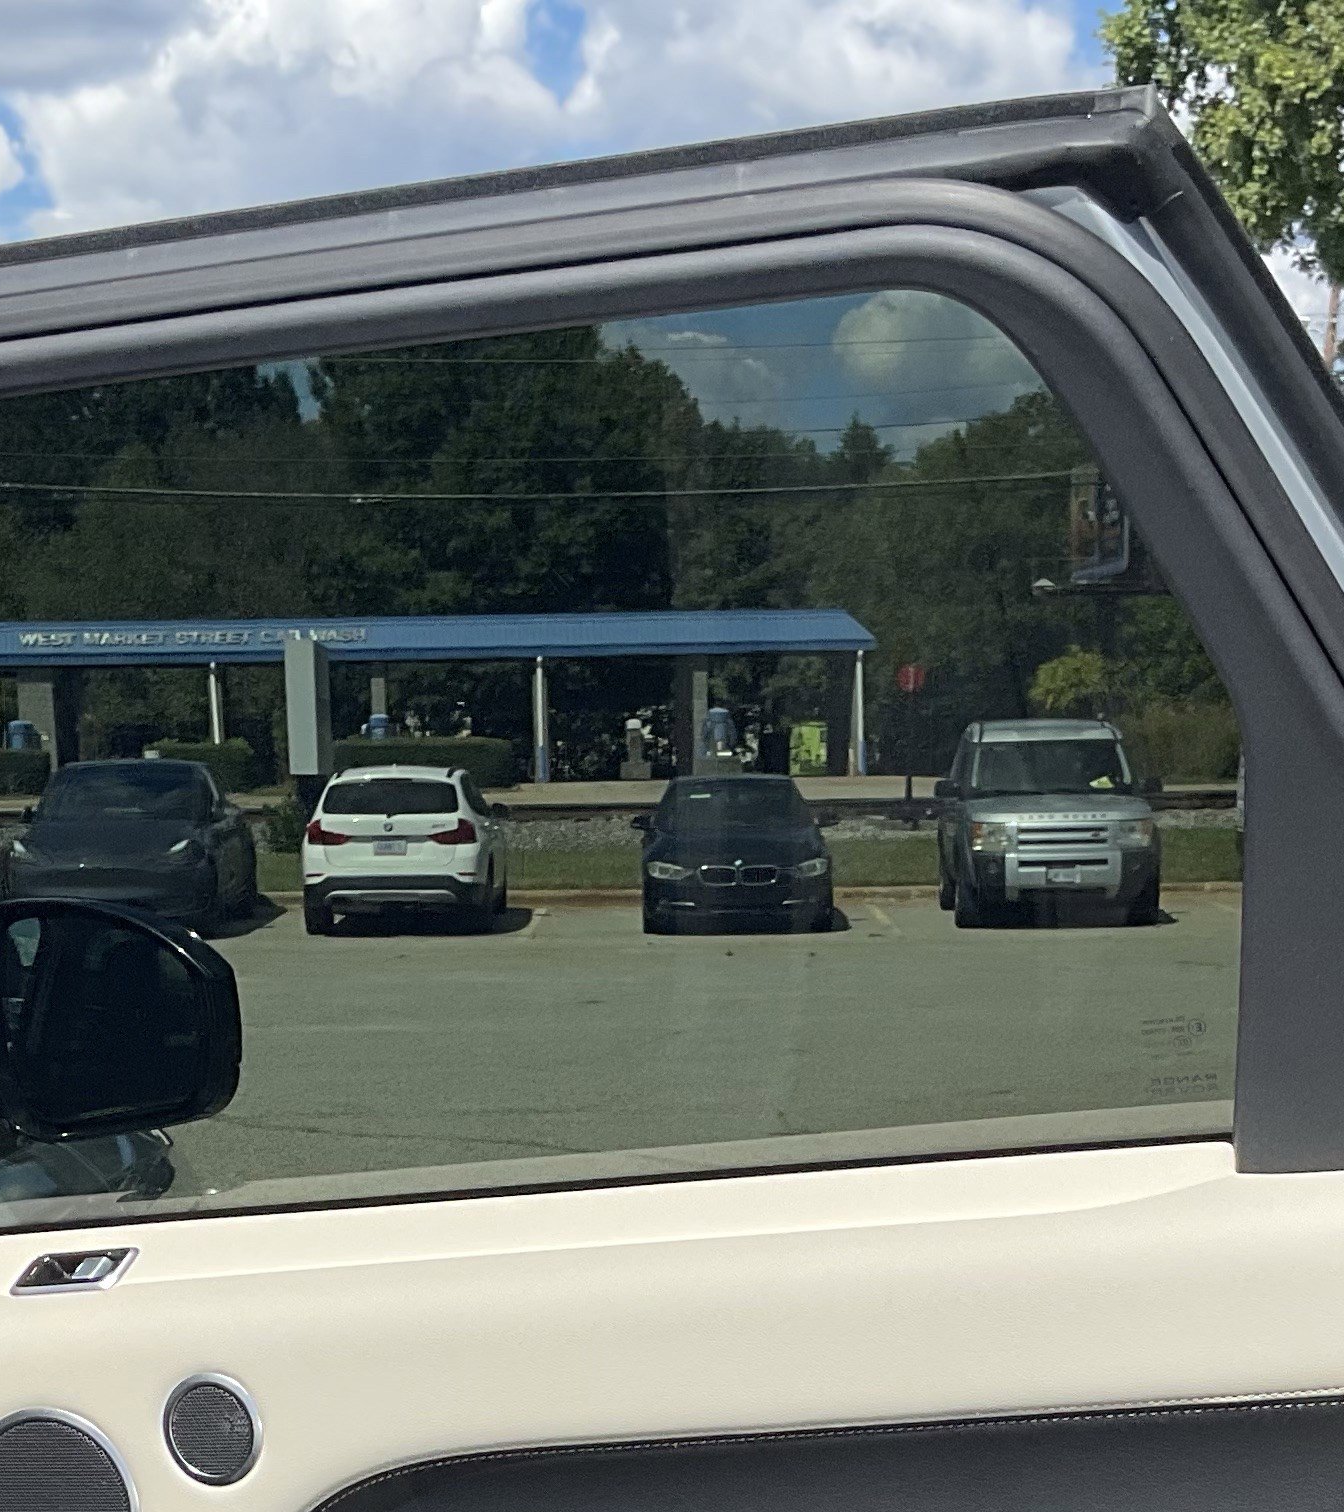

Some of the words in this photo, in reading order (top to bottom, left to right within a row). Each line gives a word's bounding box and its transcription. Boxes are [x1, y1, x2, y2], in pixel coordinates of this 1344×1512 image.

[19, 632, 76, 647] WEST
[83, 632, 168, 646] MARKET
[175, 631, 253, 646] STREET
